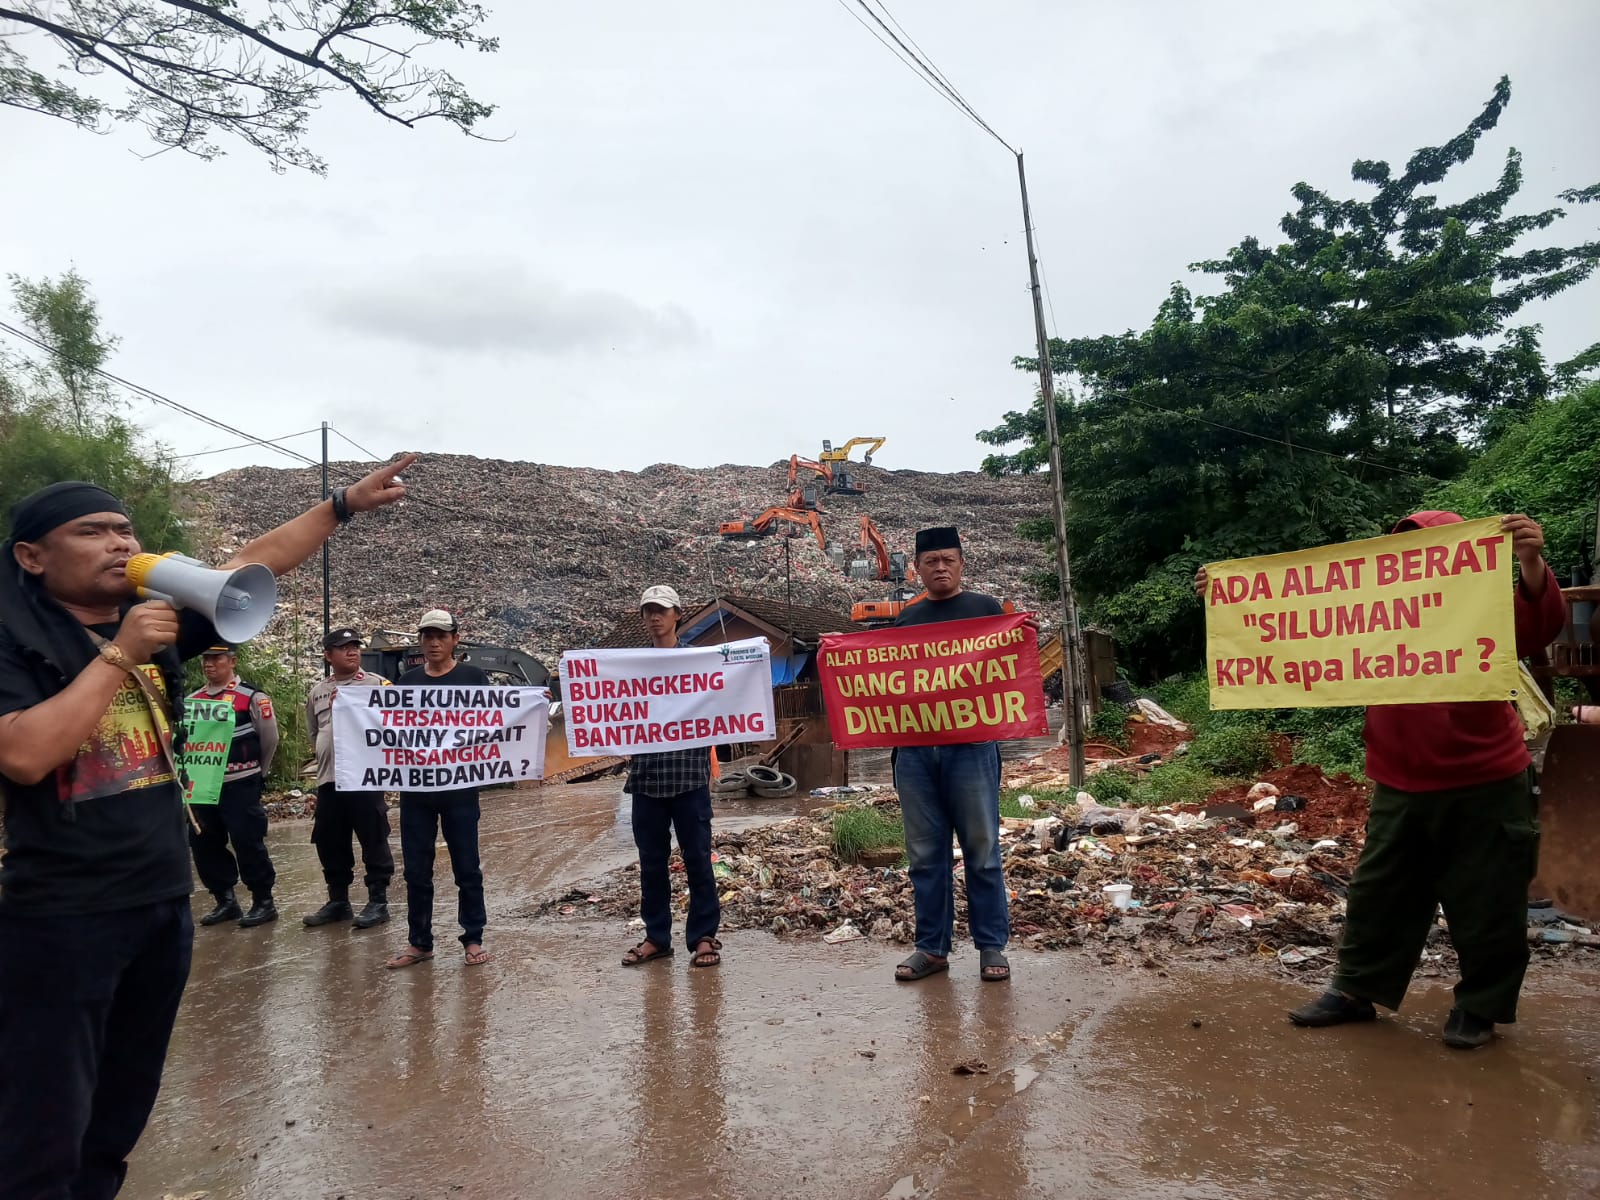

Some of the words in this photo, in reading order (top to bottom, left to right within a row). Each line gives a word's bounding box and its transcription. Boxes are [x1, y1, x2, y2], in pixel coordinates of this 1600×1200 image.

[1210, 572, 1273, 607] ADA
[1281, 557, 1366, 598] ALAT
[1376, 535, 1505, 587] BERAT
[1243, 592, 1443, 642] "SILUMAN"
[826, 649, 862, 667] ALAT
[867, 643, 919, 664] BERAT
[923, 627, 1025, 659] NGANGGUR
[567, 658, 598, 679] INI
[836, 670, 906, 698] UANG
[913, 654, 1019, 693] RAKYAT
[1215, 655, 1278, 687] KPK
[1283, 658, 1344, 692] apa
[1352, 643, 1463, 680] kabar
[1476, 637, 1496, 673] ?
[368, 689, 414, 708] ADE
[420, 689, 521, 708] KUNANG
[569, 671, 724, 701] BURANGKENG
[183, 702, 229, 722] ENG
[380, 709, 504, 727] TERSANGKA
[571, 700, 649, 724] BUKAN
[843, 690, 1028, 735] DIHAMBUR
[365, 728, 450, 748] DONNY
[452, 725, 526, 747] SIRAIT
[574, 712, 764, 748] BANTARGEBANG
[184, 741, 227, 753] NGAN
[381, 744, 501, 766] TERSANGKA
[361, 767, 404, 786] APA
[408, 760, 514, 787] BEDANYA
[520, 759, 530, 776] ?
